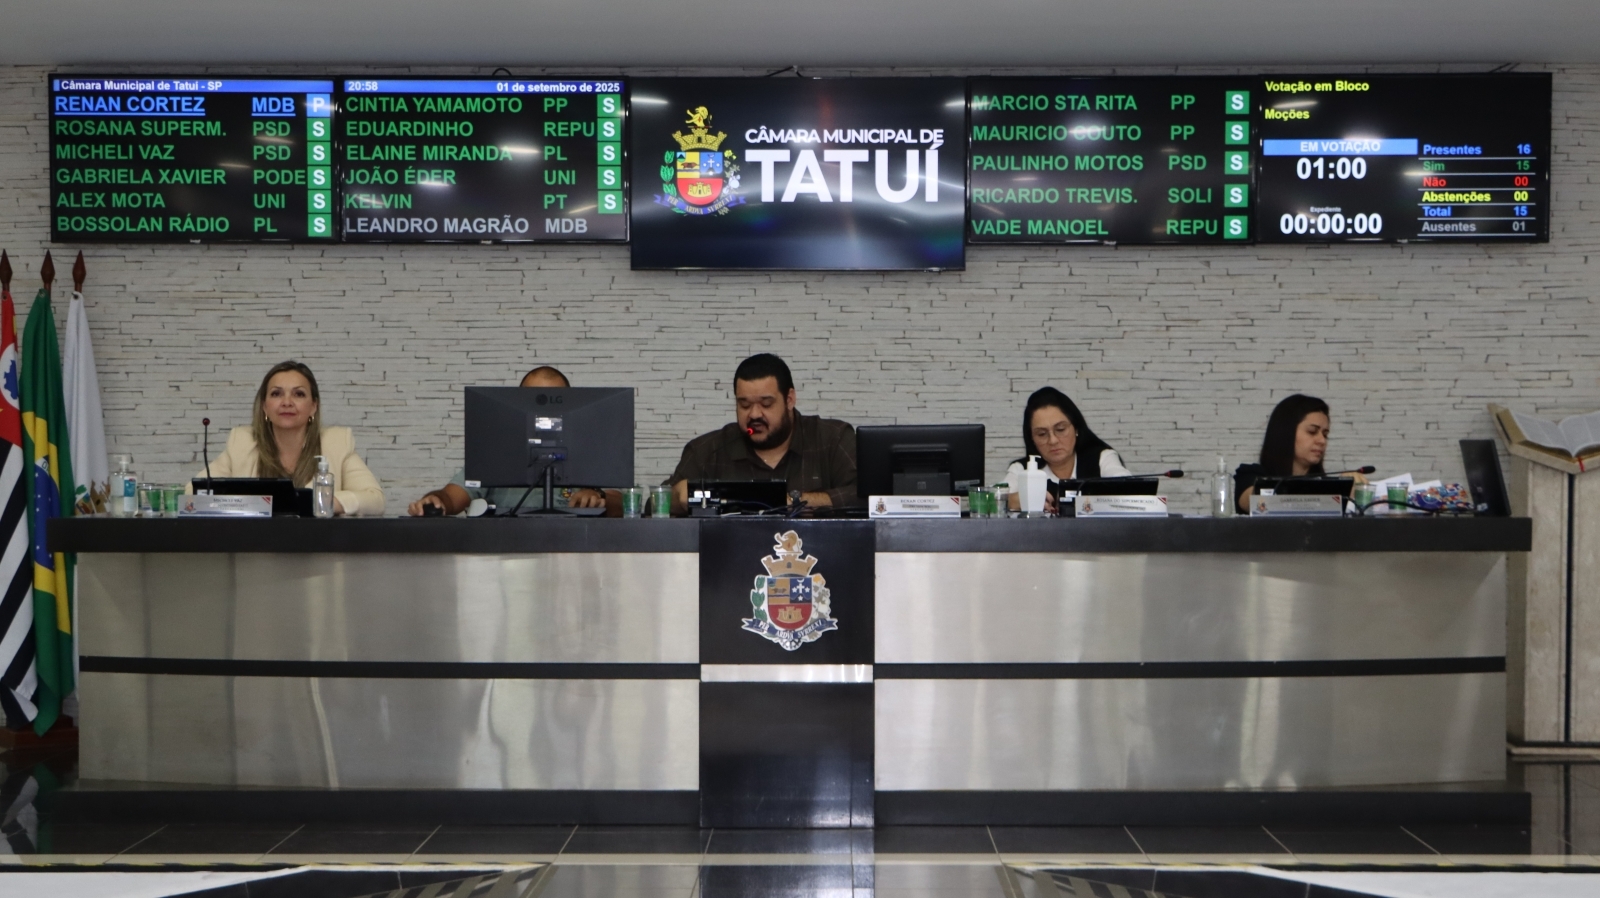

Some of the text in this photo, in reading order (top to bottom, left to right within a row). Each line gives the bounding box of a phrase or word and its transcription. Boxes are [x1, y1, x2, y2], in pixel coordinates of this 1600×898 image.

[61, 80, 101, 90] Câmara
[104, 81, 155, 92] Municipal
[157, 82, 170, 90] de
[208, 82, 222, 90] SP
[349, 82, 378, 91] 20:58
[497, 83, 620, 92] 01 de setembro de 2025
[1266, 81, 1369, 93] Votação em Bloco
[55, 96, 325, 112] RENAN CORTEZ MDB P
[346, 98, 615, 113] CINTIA YAMAMOTO PP S
[973, 95, 1243, 110] MARCIO STA RITA PP S
[1265, 110, 1310, 121] Moções
[56, 120, 324, 137] ROSANA SUPERM. PSD S
[346, 122, 615, 137] EDUARDINHO REPU S
[745, 126, 944, 144] CÂMARA MUNICIPAL DE
[973, 125, 1243, 140] MAURICIO COUTO PP S
[56, 145, 325, 160] MICHELI VAZ PSD S
[346, 145, 615, 161] ELAINE MIRANDA PL S
[1301, 139, 1380, 154] EM VOTAÇÃO
[1423, 145, 1531, 154] Presentes 16
[973, 155, 1243, 170] PAULINHO MOTOS PSD S
[1297, 157, 1367, 179] 01:00
[1423, 161, 1530, 171] Sim 15
[56, 169, 325, 185] GABRIELA XAVIER PODE S
[346, 166, 615, 185] JOÃO ÉDER UNI S
[745, 142, 944, 203] TATUÍ
[1423, 177, 1528, 186] Não 00
[56, 193, 325, 209] ALEX MOTA UNI S
[346, 194, 616, 209] KELVIN PT S
[972, 188, 1242, 203] RICARDO TREVIS. SOLI S
[1422, 192, 1528, 203] Abstenções 00
[1423, 207, 1527, 216] Total 15
[58, 214, 325, 233] BOSSOLAN RÁDIO PL S
[346, 214, 587, 233] LEANDRO MAGRÃO MDB
[972, 219, 1242, 235] VADE MANOEL REPU S
[1280, 213, 1382, 234] 00:00:00
[1422, 222, 1525, 232] Ausentes 01
[758, 621, 769, 629] PER
